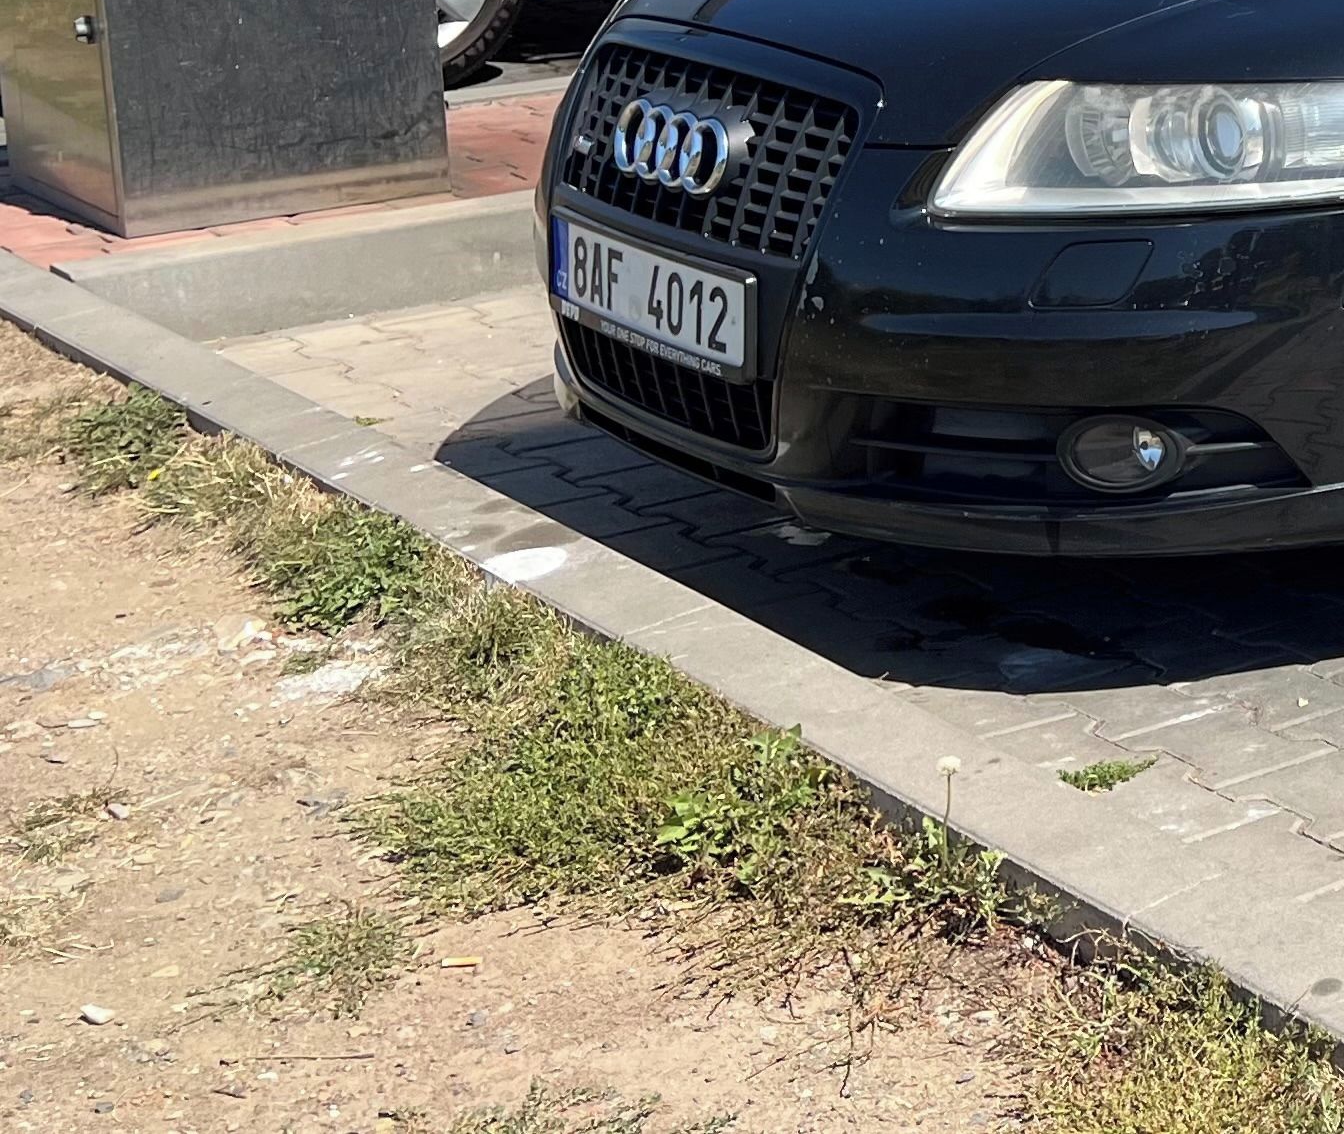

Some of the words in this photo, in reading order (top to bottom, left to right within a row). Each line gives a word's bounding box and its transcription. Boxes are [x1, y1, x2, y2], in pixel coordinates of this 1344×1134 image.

[556, 270, 568, 290] CZ
[573, 236, 623, 311] 8AF
[647, 265, 728, 354] 4012
[600, 319, 617, 338] YOUR
[617, 329, 630, 344] ONE
[630, 331, 645, 348] STOP
[646, 338, 660, 355] FOR
[660, 343, 701, 369] EVERYTHING
[700, 359, 722, 377] CARS
